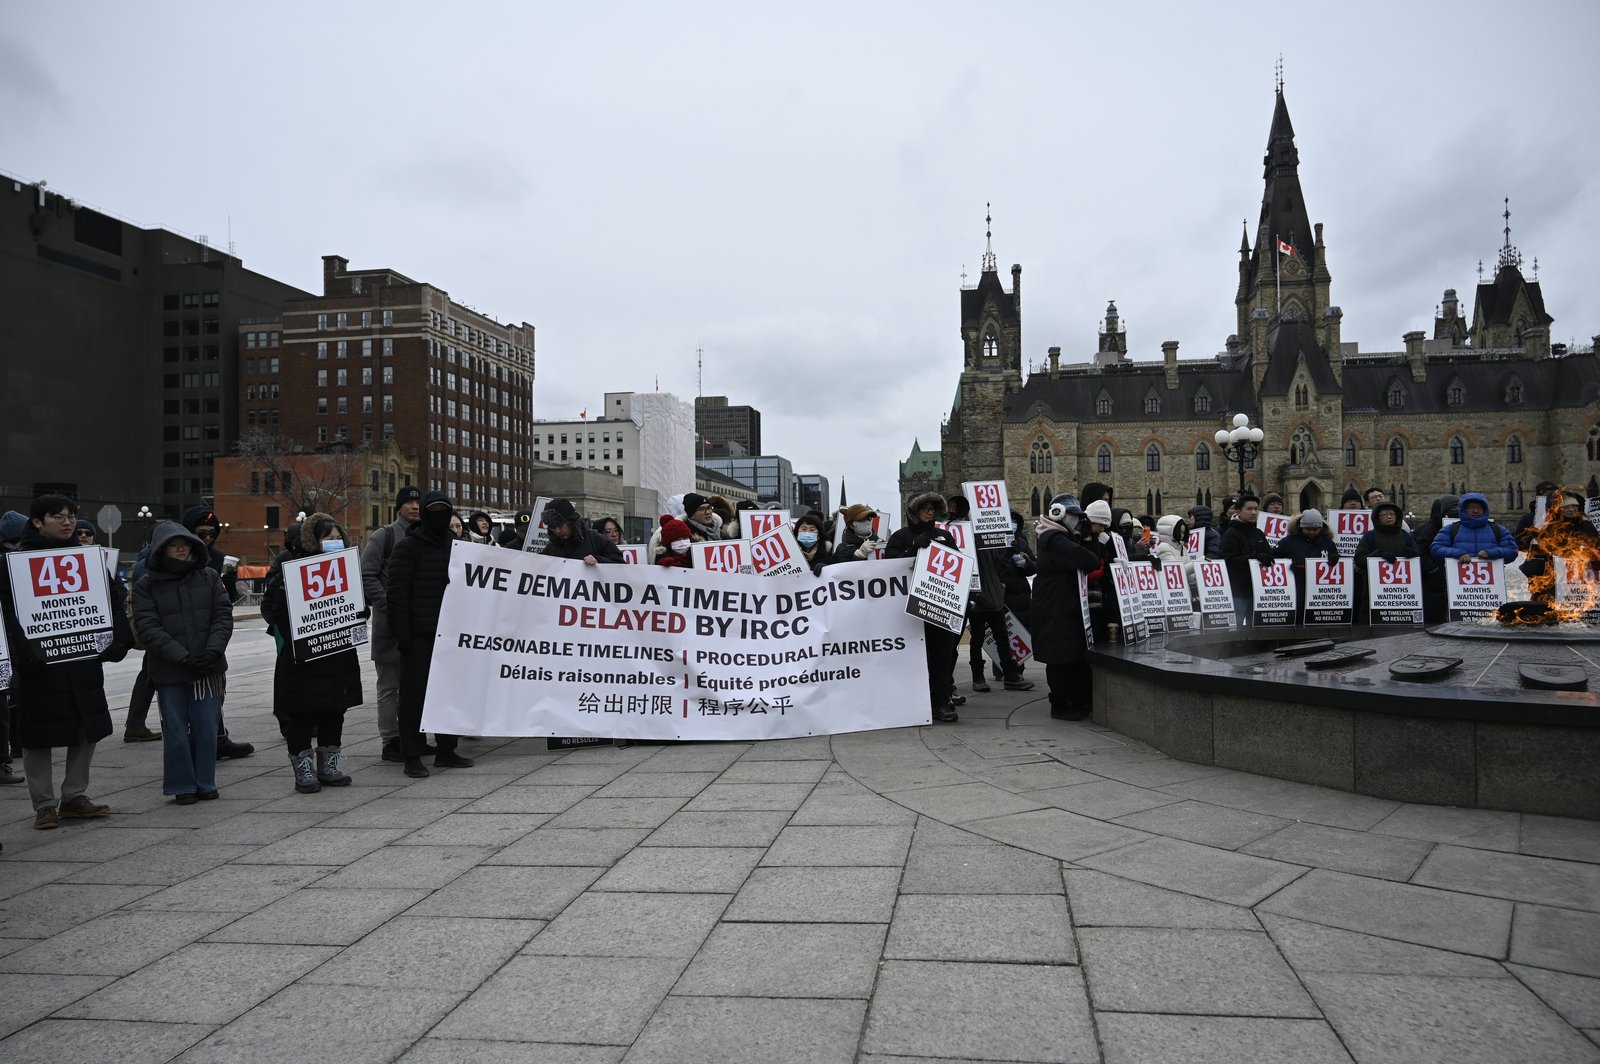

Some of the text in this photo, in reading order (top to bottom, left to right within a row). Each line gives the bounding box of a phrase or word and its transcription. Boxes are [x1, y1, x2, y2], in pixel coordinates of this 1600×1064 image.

[978, 485, 998, 508] 39
[1268, 518, 1288, 538] 19
[1342, 514, 1364, 534] 16
[709, 546, 739, 574] 40
[751, 536, 785, 570] 90
[38, 555, 83, 594] 43
[932, 550, 959, 582] 42
[1164, 565, 1184, 590] 51
[1203, 564, 1223, 587] 36
[1263, 563, 1285, 586] 38
[1318, 562, 1342, 584] 24
[1382, 561, 1408, 584] 34
[1461, 562, 1490, 585] 35
[306, 558, 344, 599] 54
[464, 562, 908, 615] WE DEMAND A TIMELY DECISION
[928, 576, 954, 591] MONTHS
[1138, 566, 1158, 590] 55
[914, 586, 961, 612] IRCC RESPONSE
[920, 580, 960, 602] WAITING FOR
[31, 605, 98, 622] WAITING FOR
[41, 596, 86, 610] MONTHS
[301, 602, 355, 624] WAITING FOR
[310, 596, 345, 612] MONTHS
[918, 608, 926, 616] NO
[26, 615, 106, 636] IRCC RESPONSE
[298, 624, 319, 636] IRCC
[558, 604, 810, 640] DELAYED BY IRCC
[40, 633, 94, 648] NO TIMELINE
[308, 638, 318, 646] NO
[312, 646, 322, 654] NO
[458, 632, 906, 666] REASONABLE TIMELINES PROCEDURAL FAIRNESS
[500, 664, 861, 692] Délais raisonnables Équité procédurale
[578, 692, 794, 716] 给出时限 程序公平
